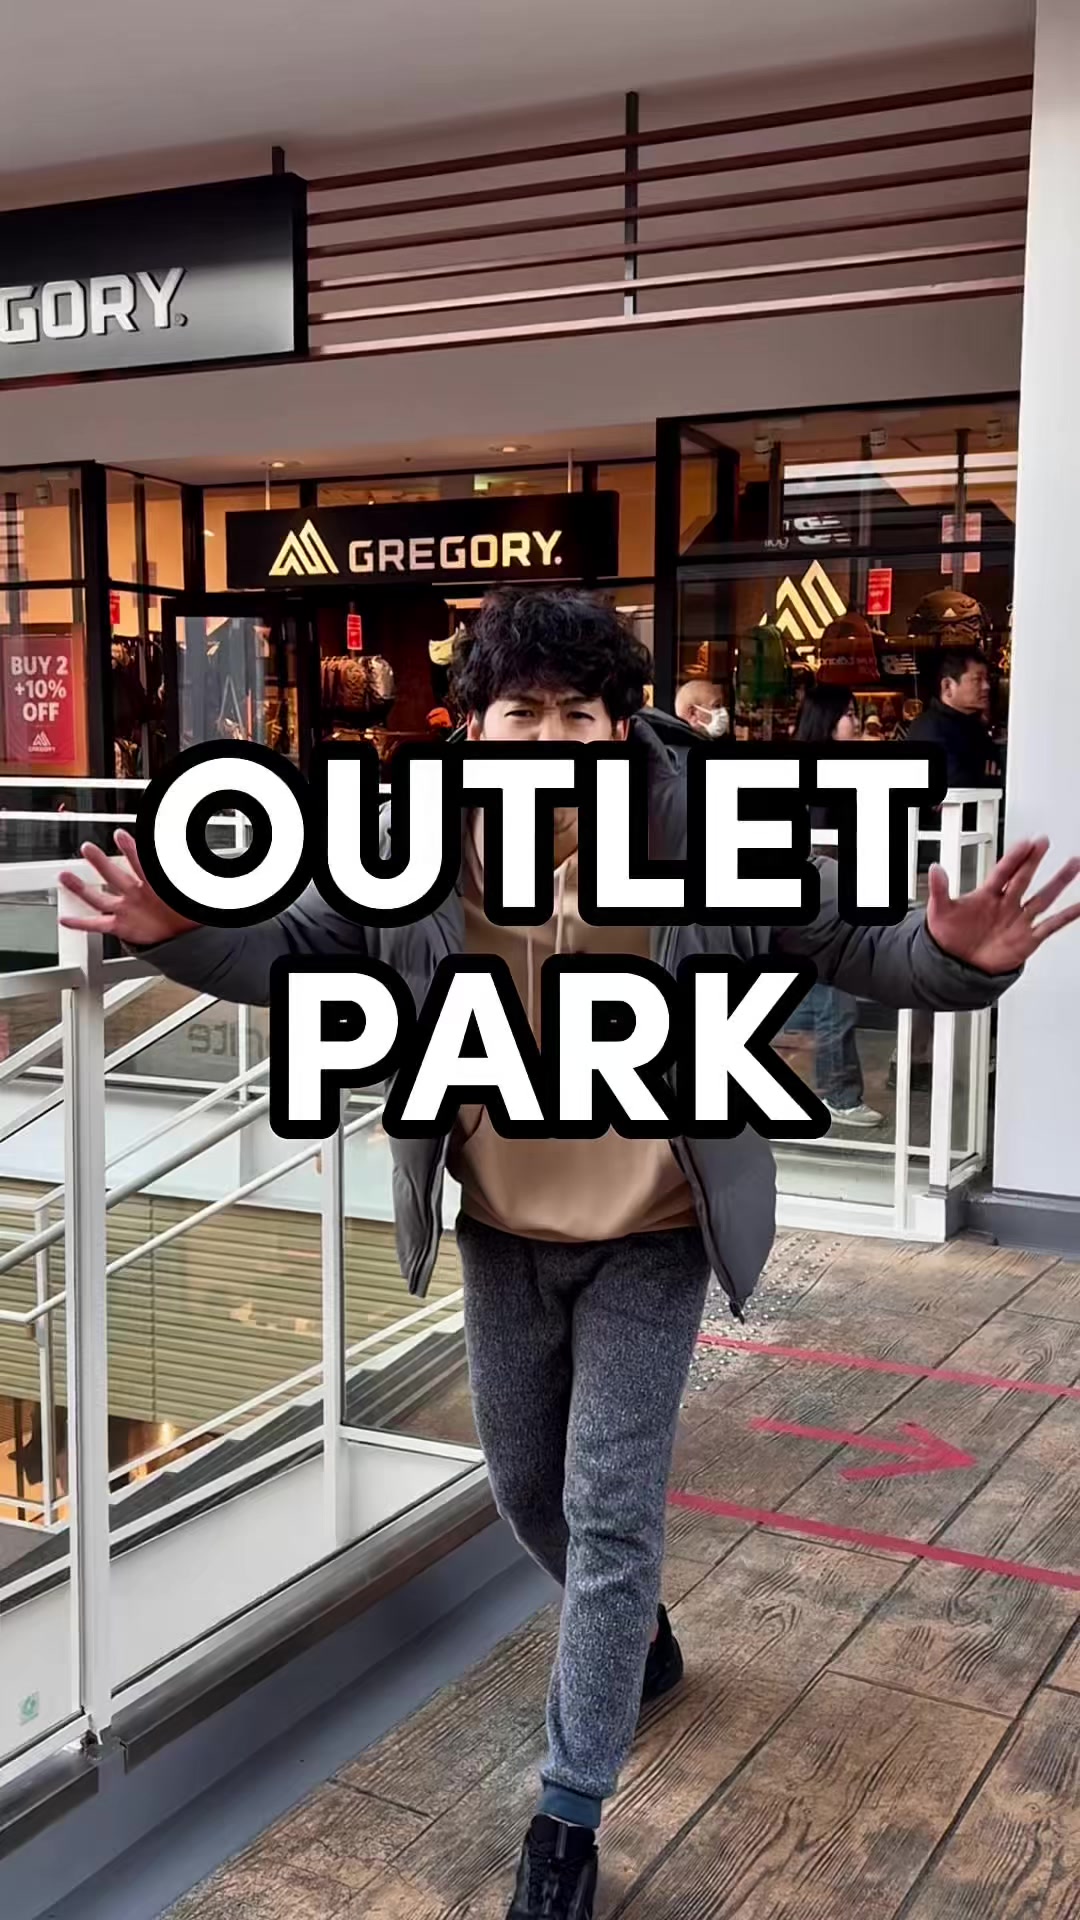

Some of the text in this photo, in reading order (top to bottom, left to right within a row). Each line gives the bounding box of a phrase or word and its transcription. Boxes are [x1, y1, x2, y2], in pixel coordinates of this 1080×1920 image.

[11, 656, 69, 675] BUY 2
[14, 679, 67, 699] +10%
[22, 702, 60, 722] OFF
